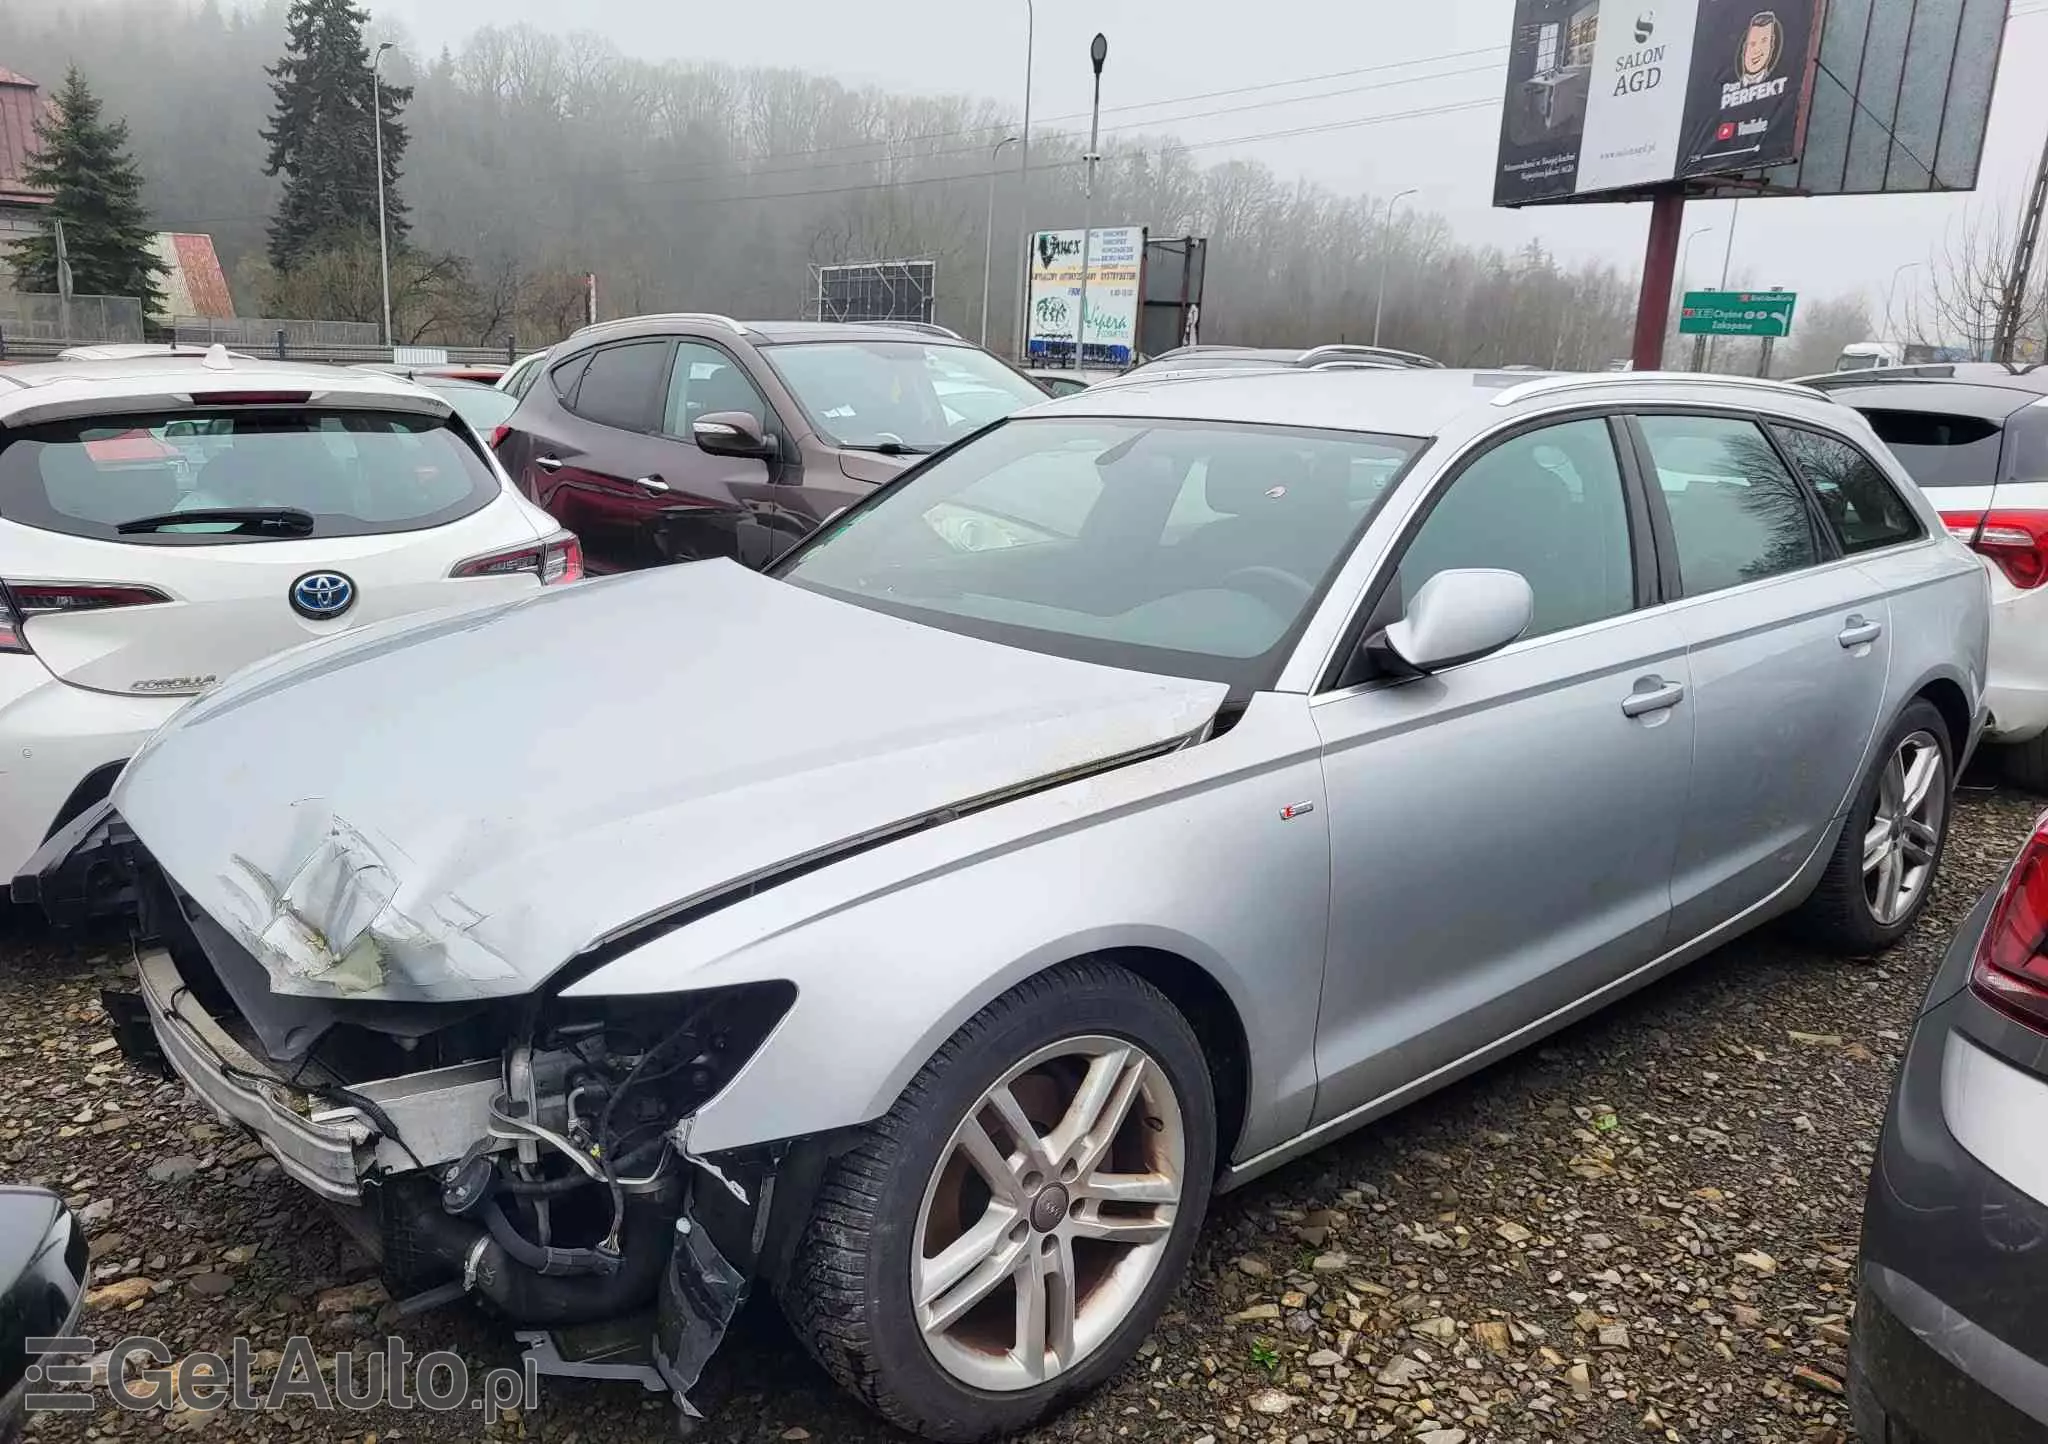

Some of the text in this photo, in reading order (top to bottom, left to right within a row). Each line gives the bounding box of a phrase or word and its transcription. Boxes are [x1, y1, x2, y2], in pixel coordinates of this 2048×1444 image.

[1615, 44, 1666, 73] SALON
[1613, 67, 1662, 97] AGD
[1720, 76, 1788, 110] PERFEKT
